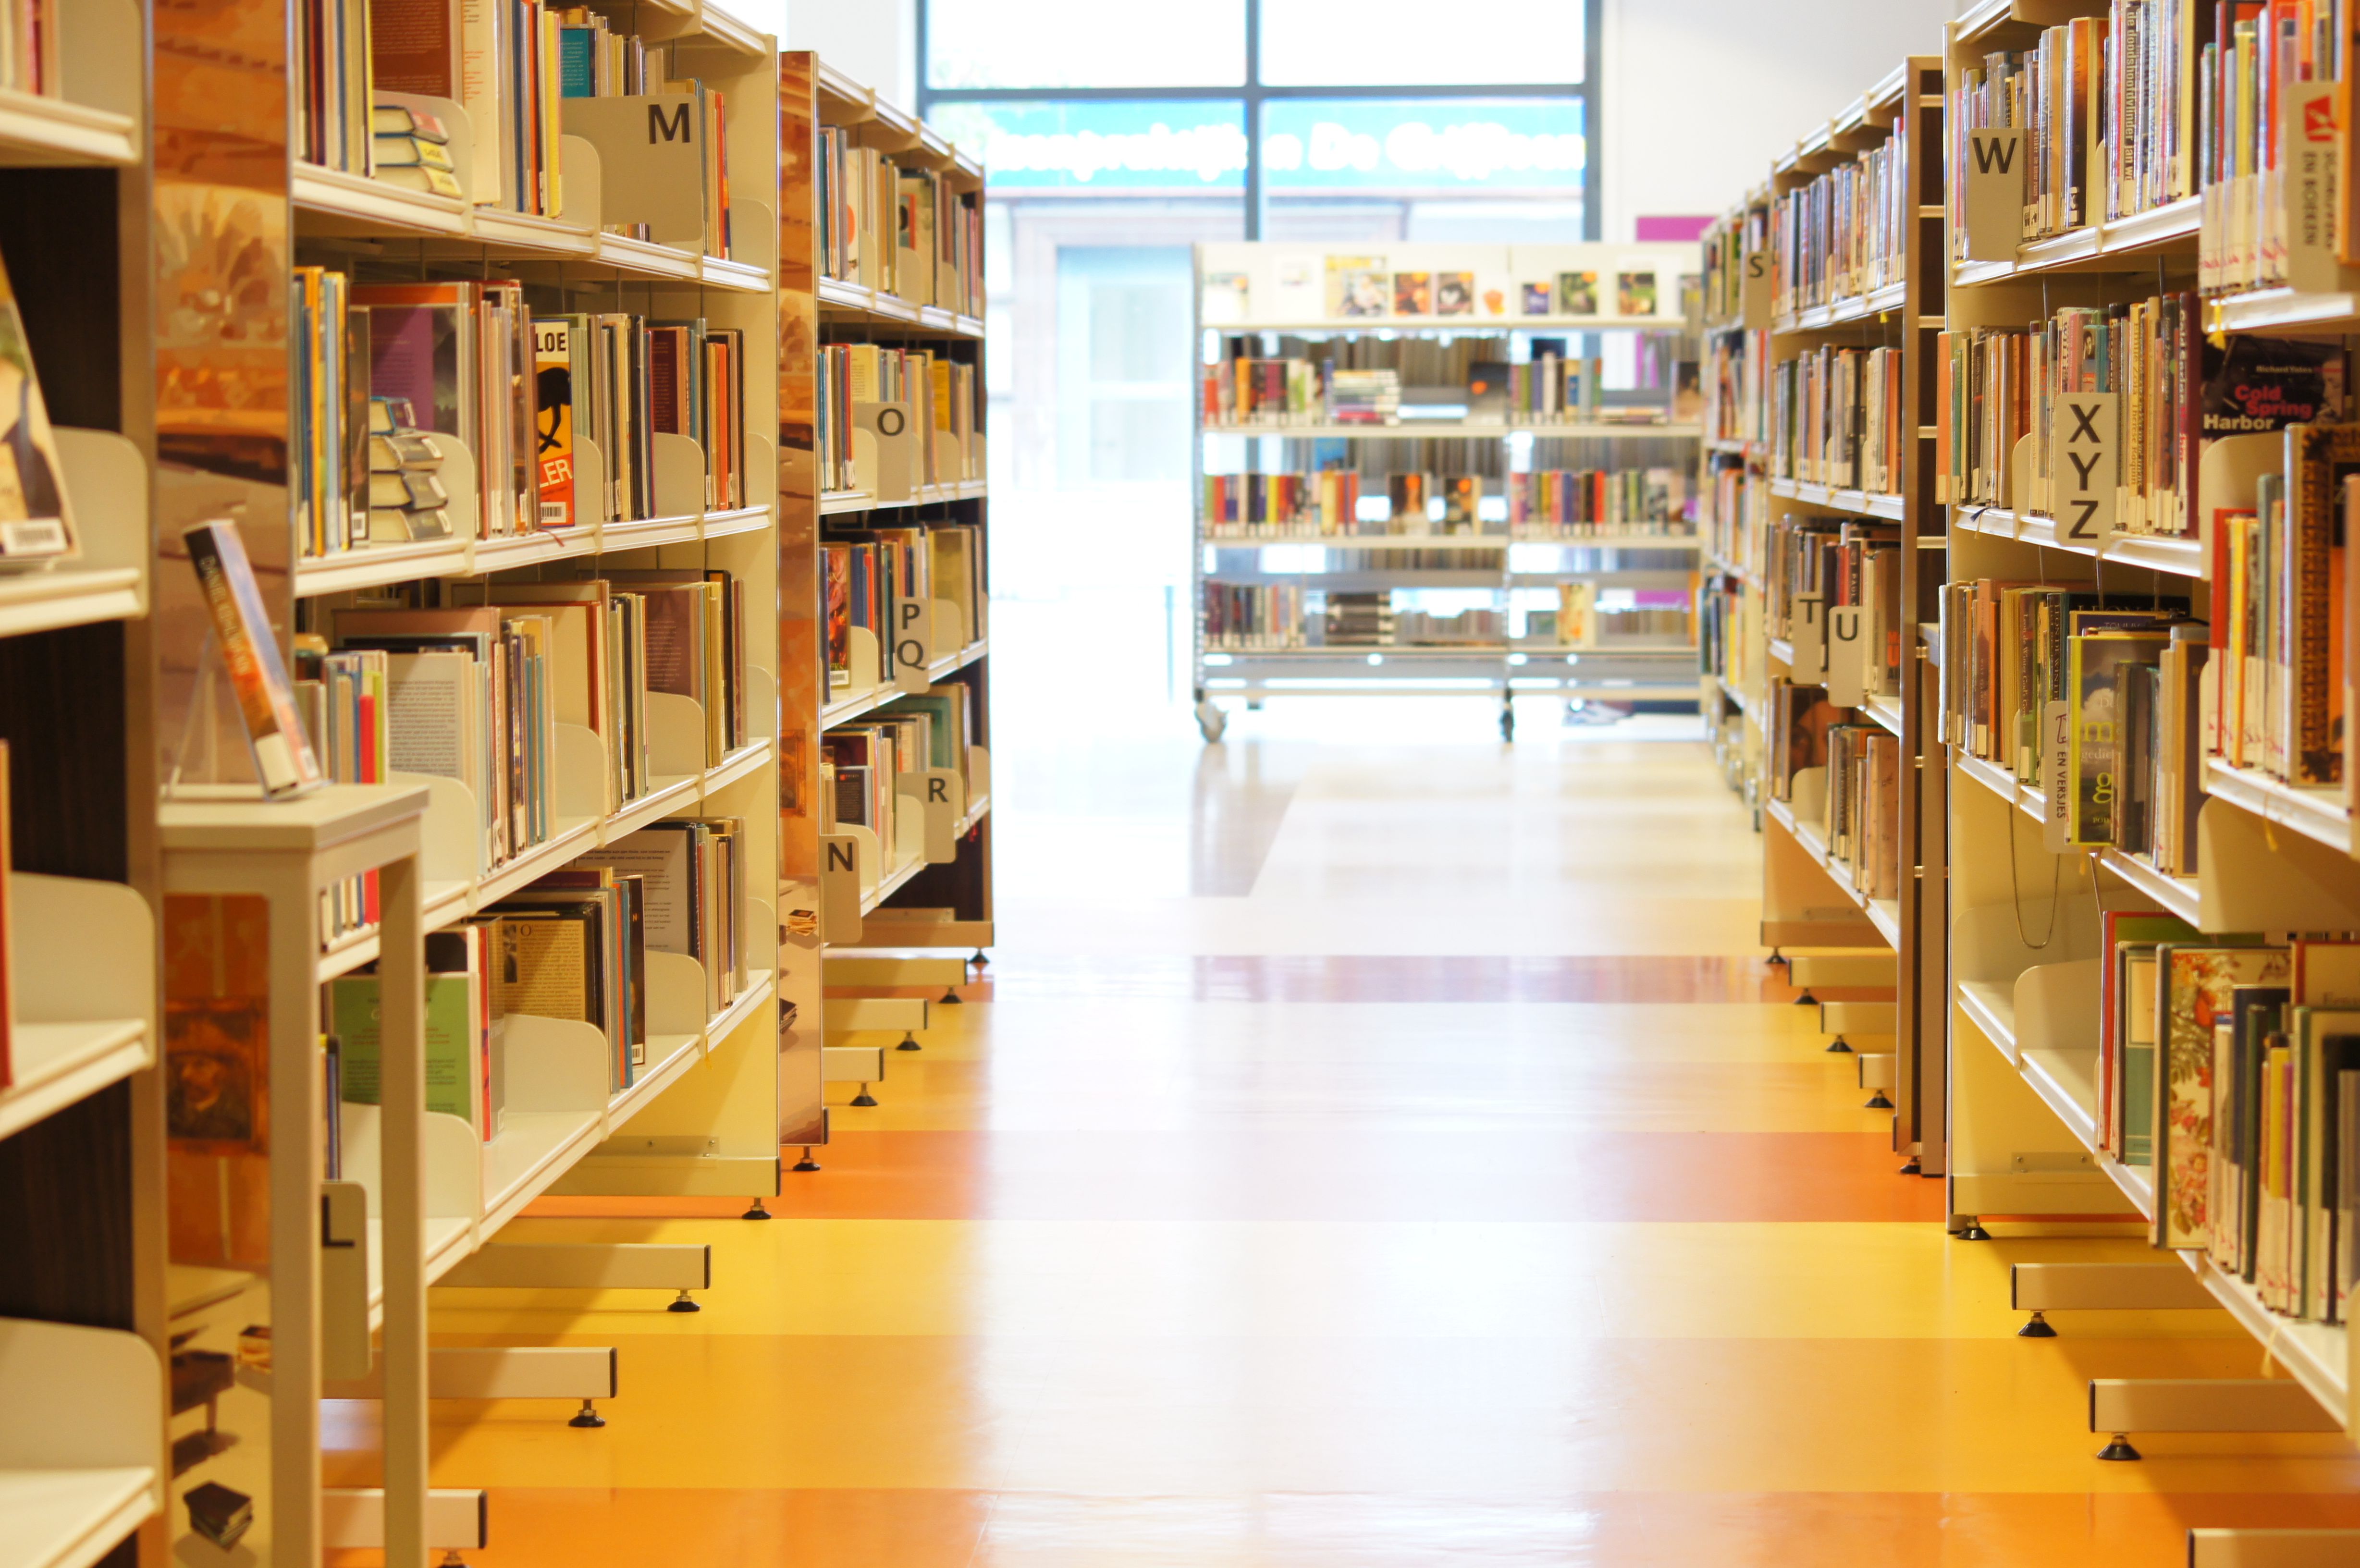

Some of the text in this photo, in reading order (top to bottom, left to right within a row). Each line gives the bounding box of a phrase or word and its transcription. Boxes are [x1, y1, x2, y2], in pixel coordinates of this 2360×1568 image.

[2126, 11, 2137, 32] de
[2125, 30, 2138, 140] doodshoofdvlinder
[648, 103, 690, 144] M
[1972, 136, 2018, 174] W
[1748, 256, 1764, 279] S
[2235, 384, 2282, 401] Cold
[877, 408, 905, 437] O
[2203, 413, 2274, 430] Harbor
[2245, 398, 2313, 419] Spring
[2068, 404, 2101, 443] X
[2068, 452, 2103, 491] Y
[2068, 500, 2100, 540] Z
[901, 603, 920, 630] P
[1798, 599, 1823, 625] T
[1836, 614, 1858, 641] U
[897, 639, 926, 671] Q
[928, 778, 948, 803] R
[2056, 752, 2067, 820] EN VERSJES
[828, 842, 853, 872] N
[321, 1194, 355, 1248] L
